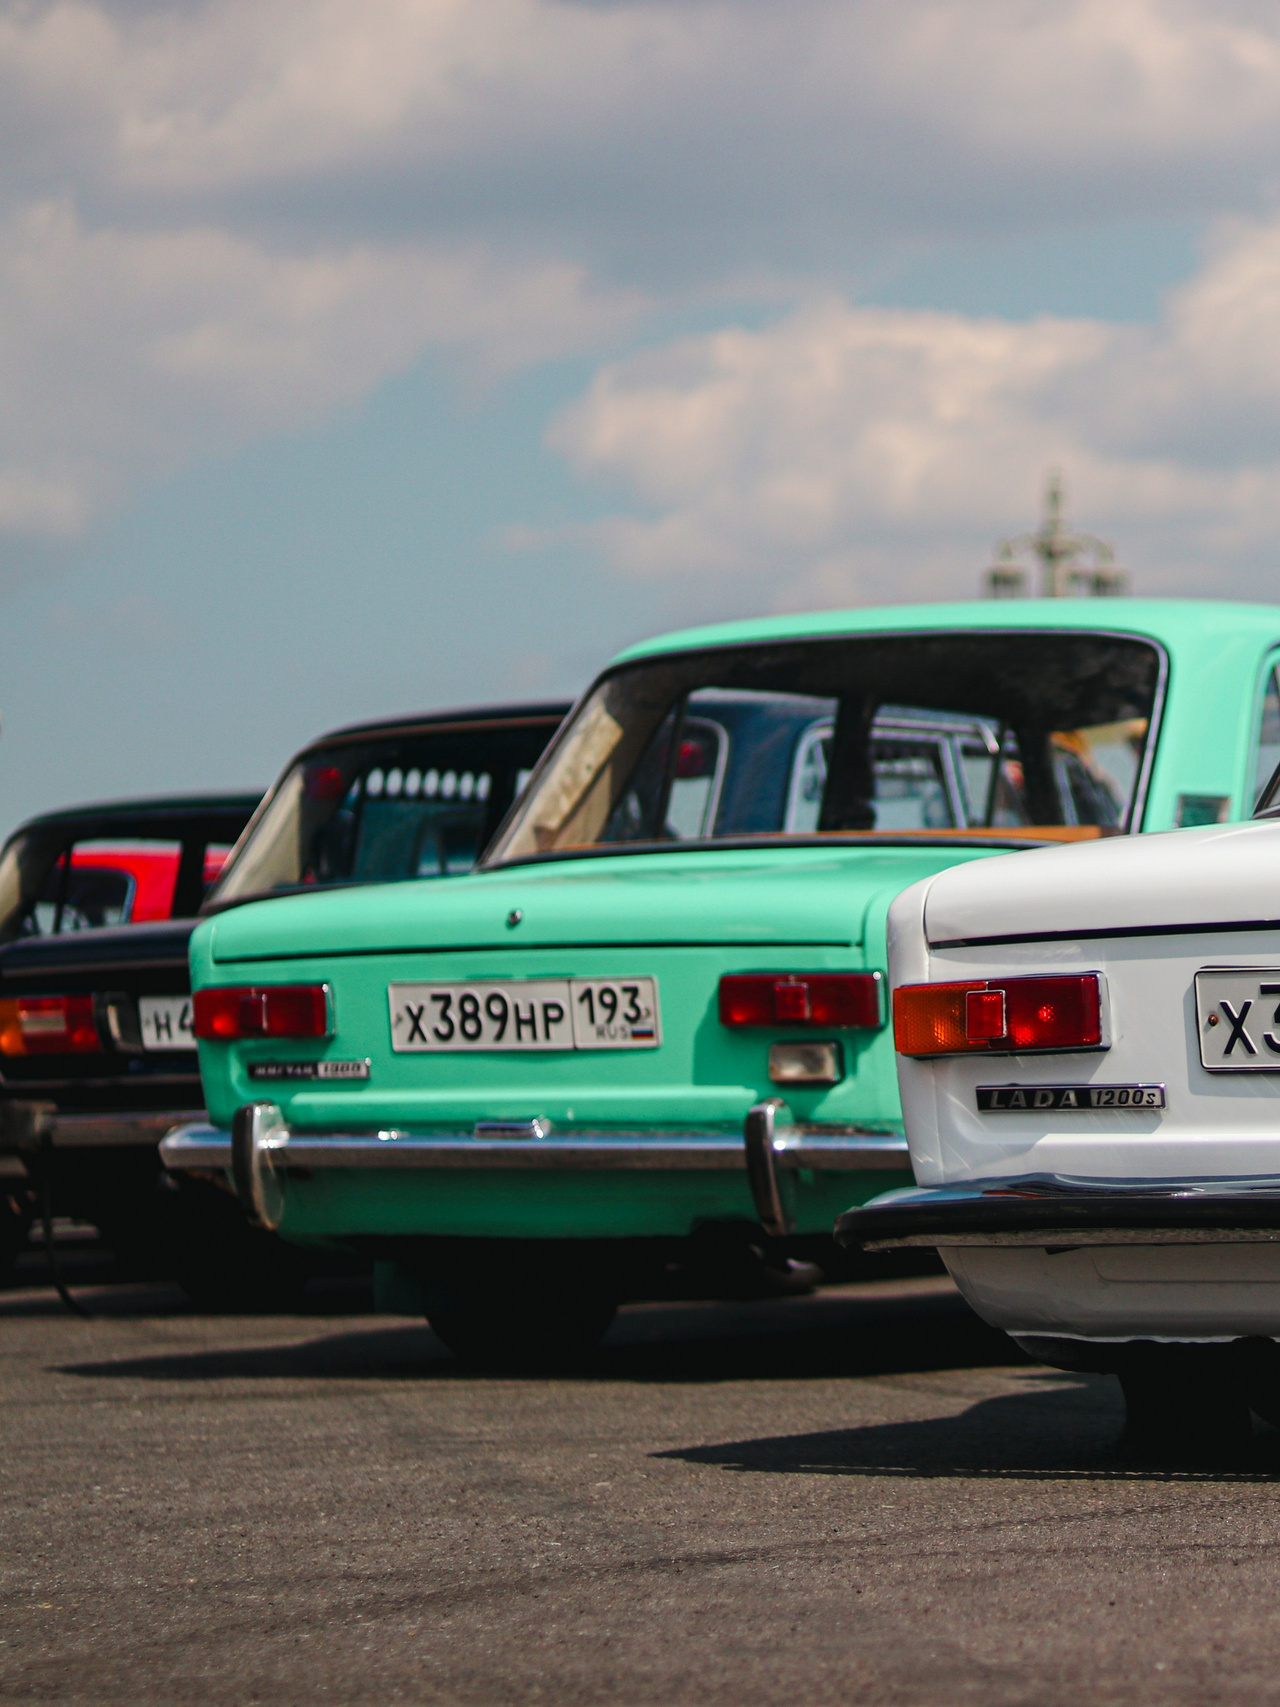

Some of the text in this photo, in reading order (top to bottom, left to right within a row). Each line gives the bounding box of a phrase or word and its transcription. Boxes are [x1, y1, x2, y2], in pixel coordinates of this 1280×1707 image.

[405, 986, 642, 1042] Х389НР 193
[596, 1025, 629, 1040] RUS
[989, 1090, 1079, 1108] LADA
